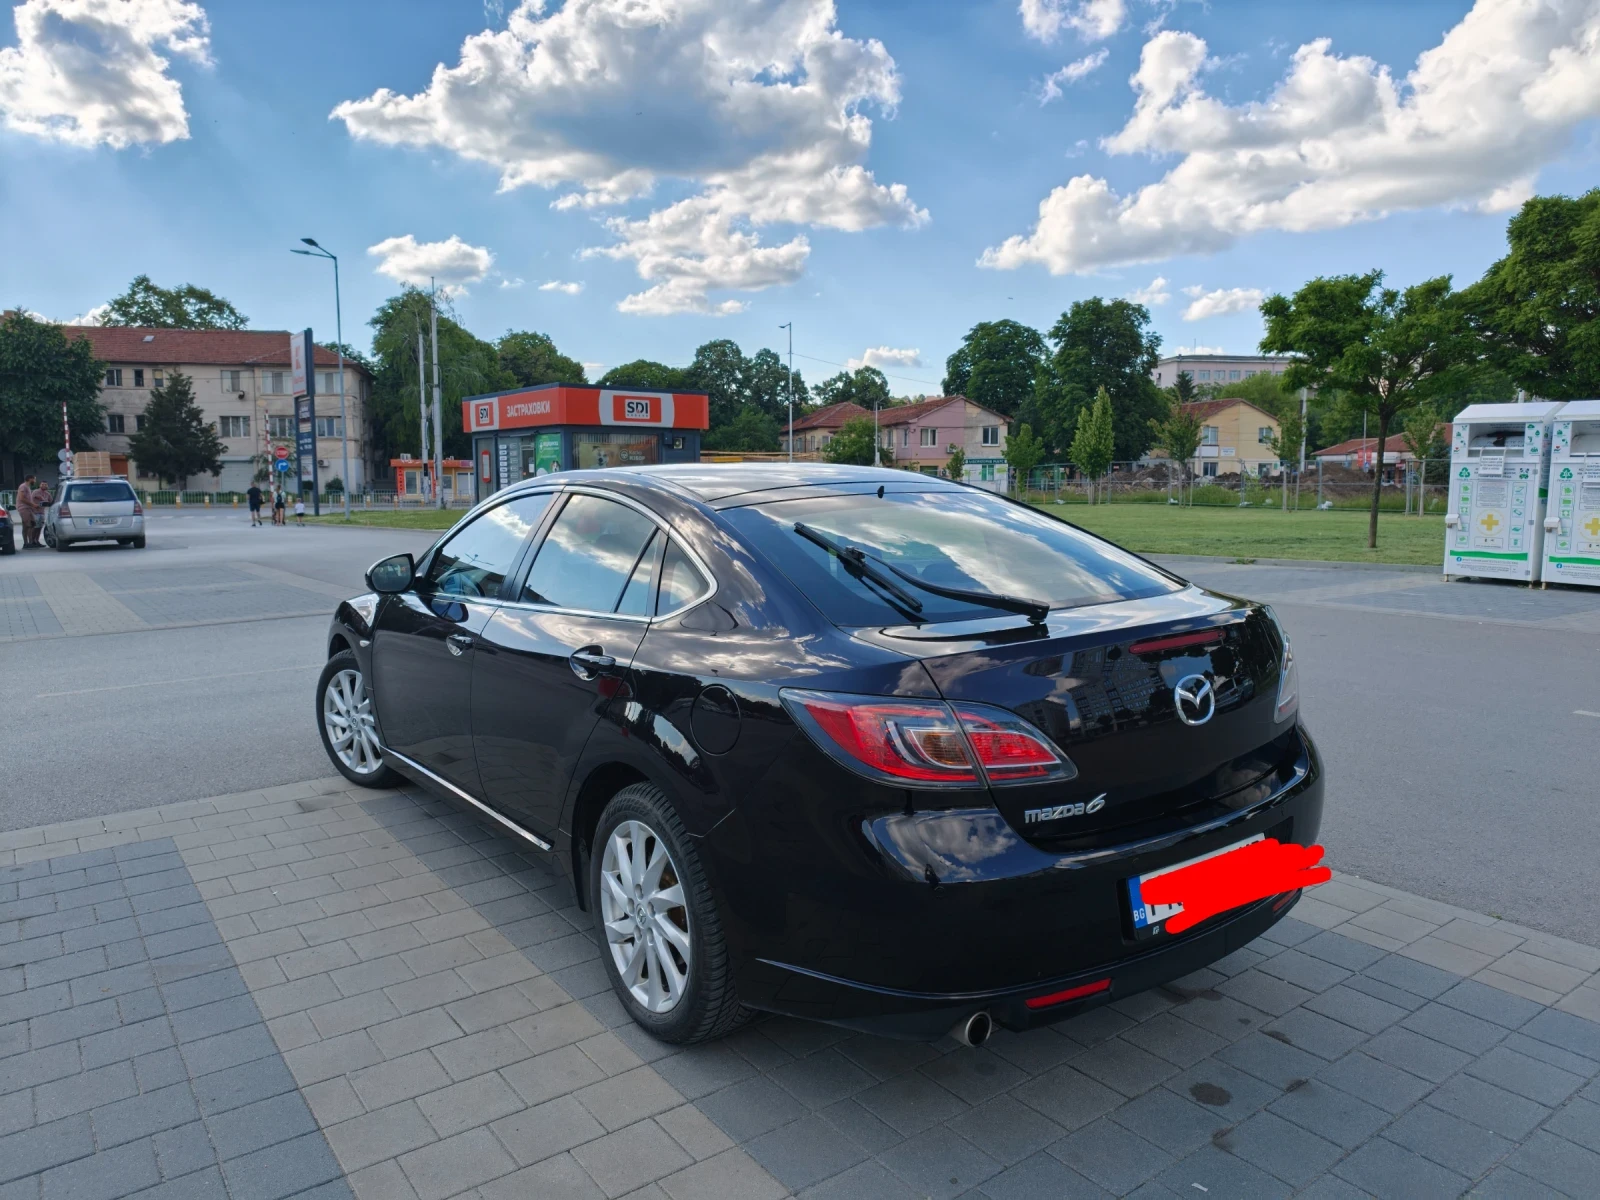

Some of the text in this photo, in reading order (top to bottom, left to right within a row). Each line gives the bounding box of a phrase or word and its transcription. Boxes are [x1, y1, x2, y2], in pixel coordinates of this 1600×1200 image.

[507, 401, 551, 418] ЗАСТРАХОВКИ
[627, 401, 648, 414] SDI
[1133, 908, 1146, 922] BG
